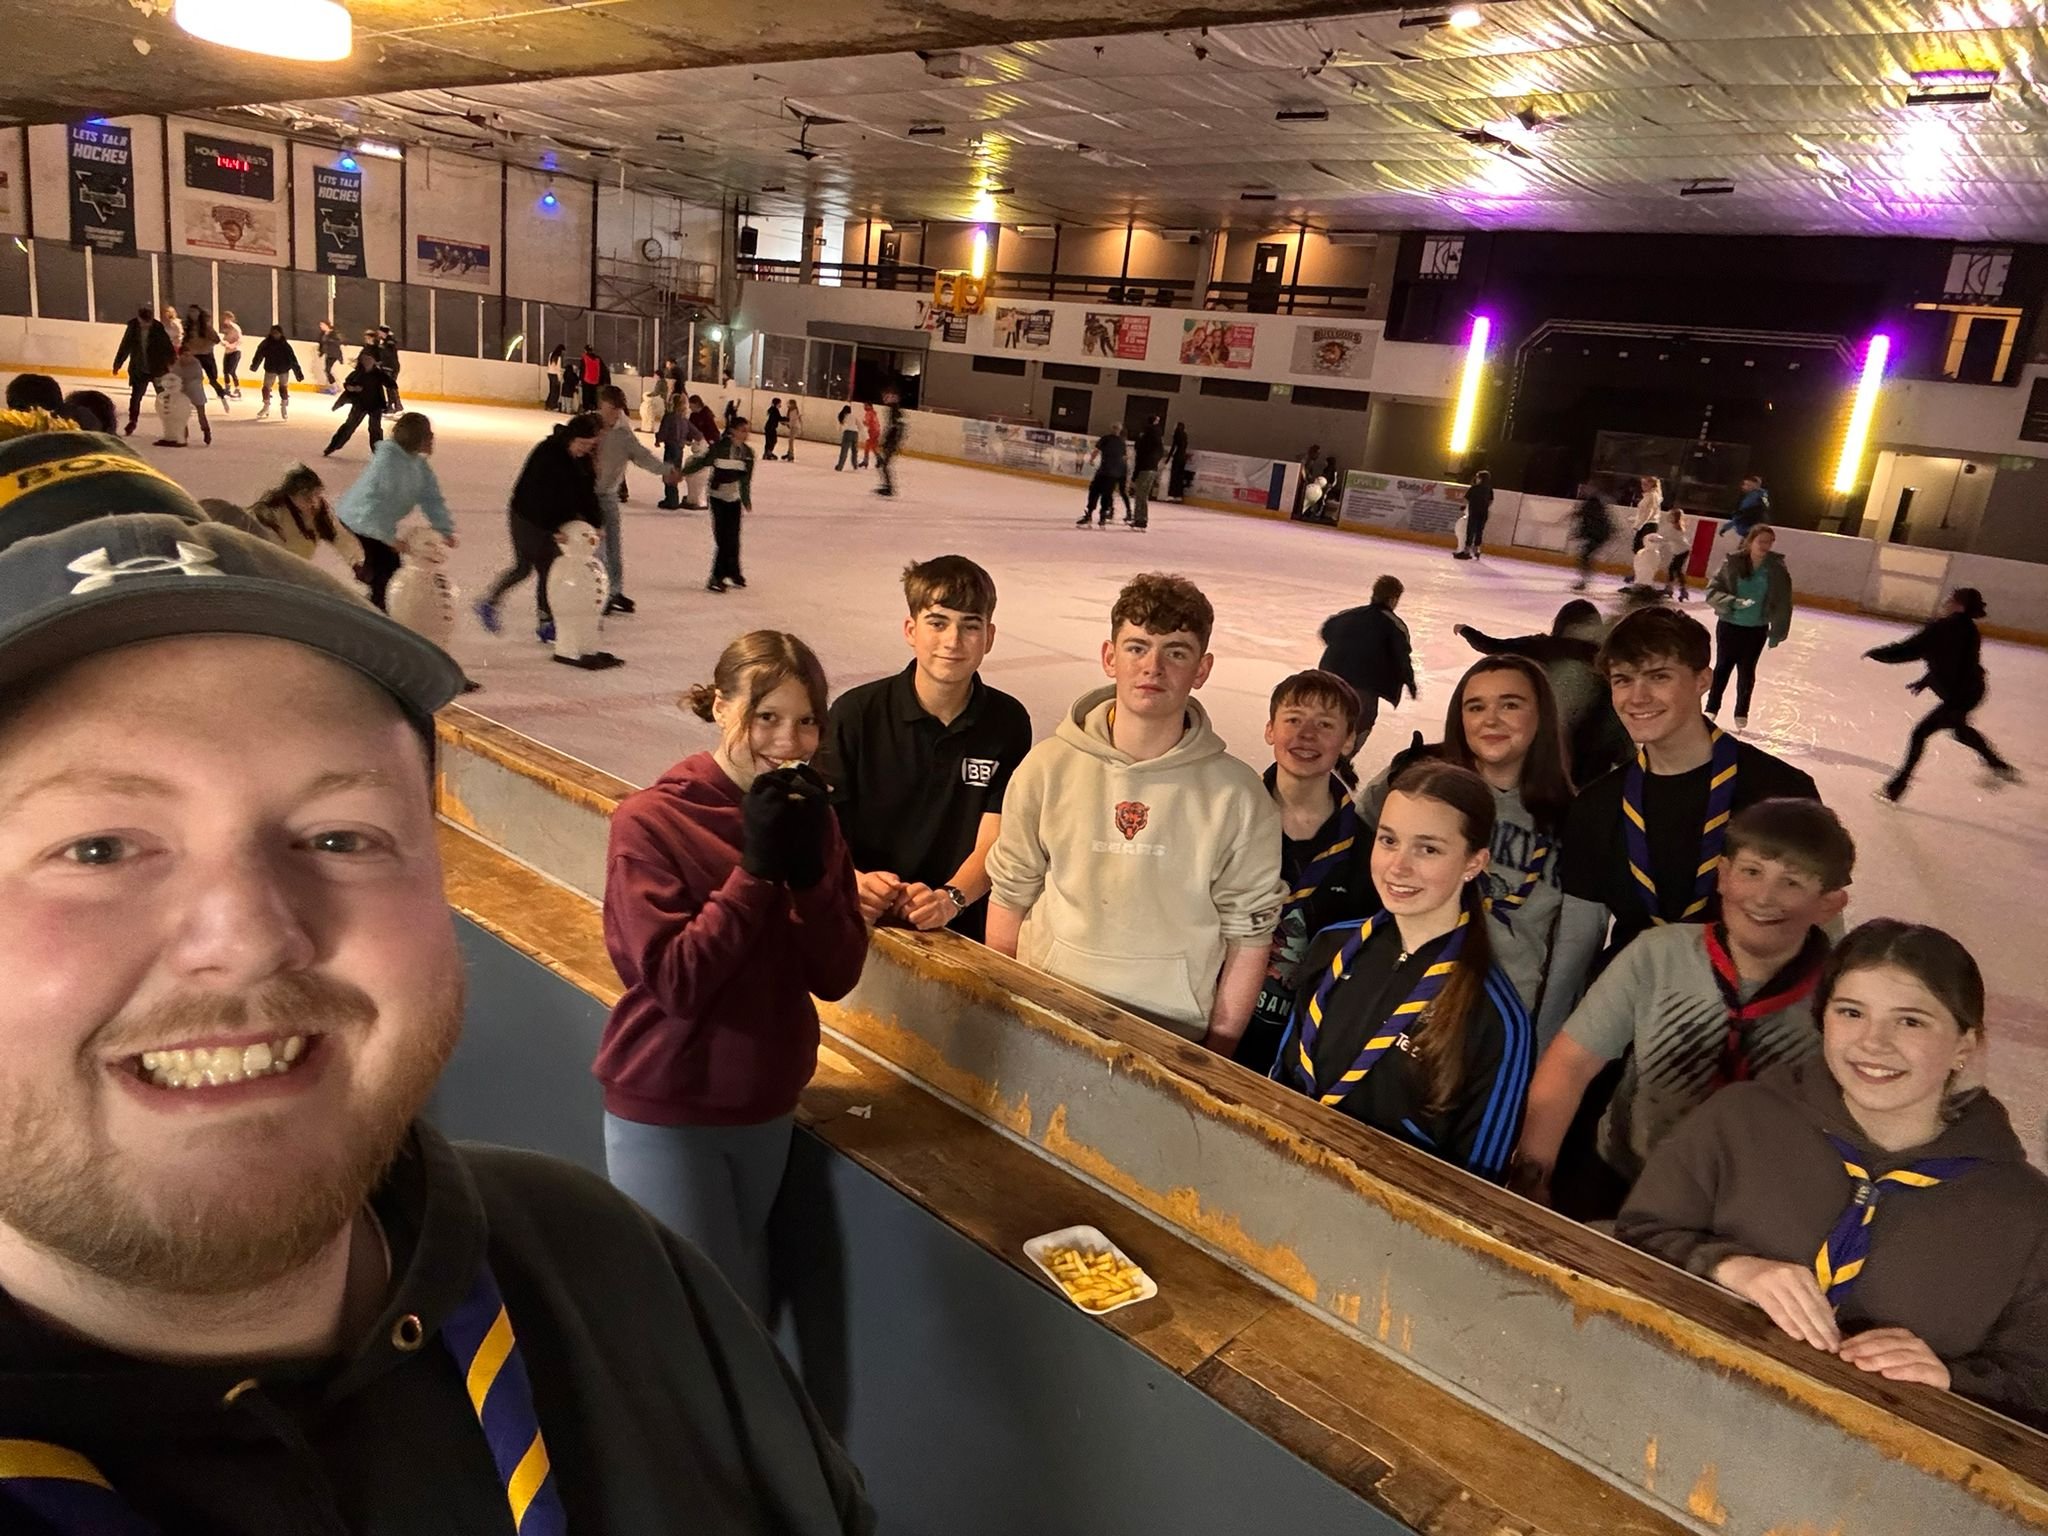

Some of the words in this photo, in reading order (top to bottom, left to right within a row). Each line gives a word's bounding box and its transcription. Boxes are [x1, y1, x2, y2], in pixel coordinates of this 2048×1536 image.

[72, 127, 98, 142] LETS
[72, 143, 128, 165] HOCKEY
[318, 174, 337, 185] LETS
[318, 186, 360, 203] HOCKEY
[968, 764, 991, 780] BB
[1091, 841, 1167, 857] BEARS
